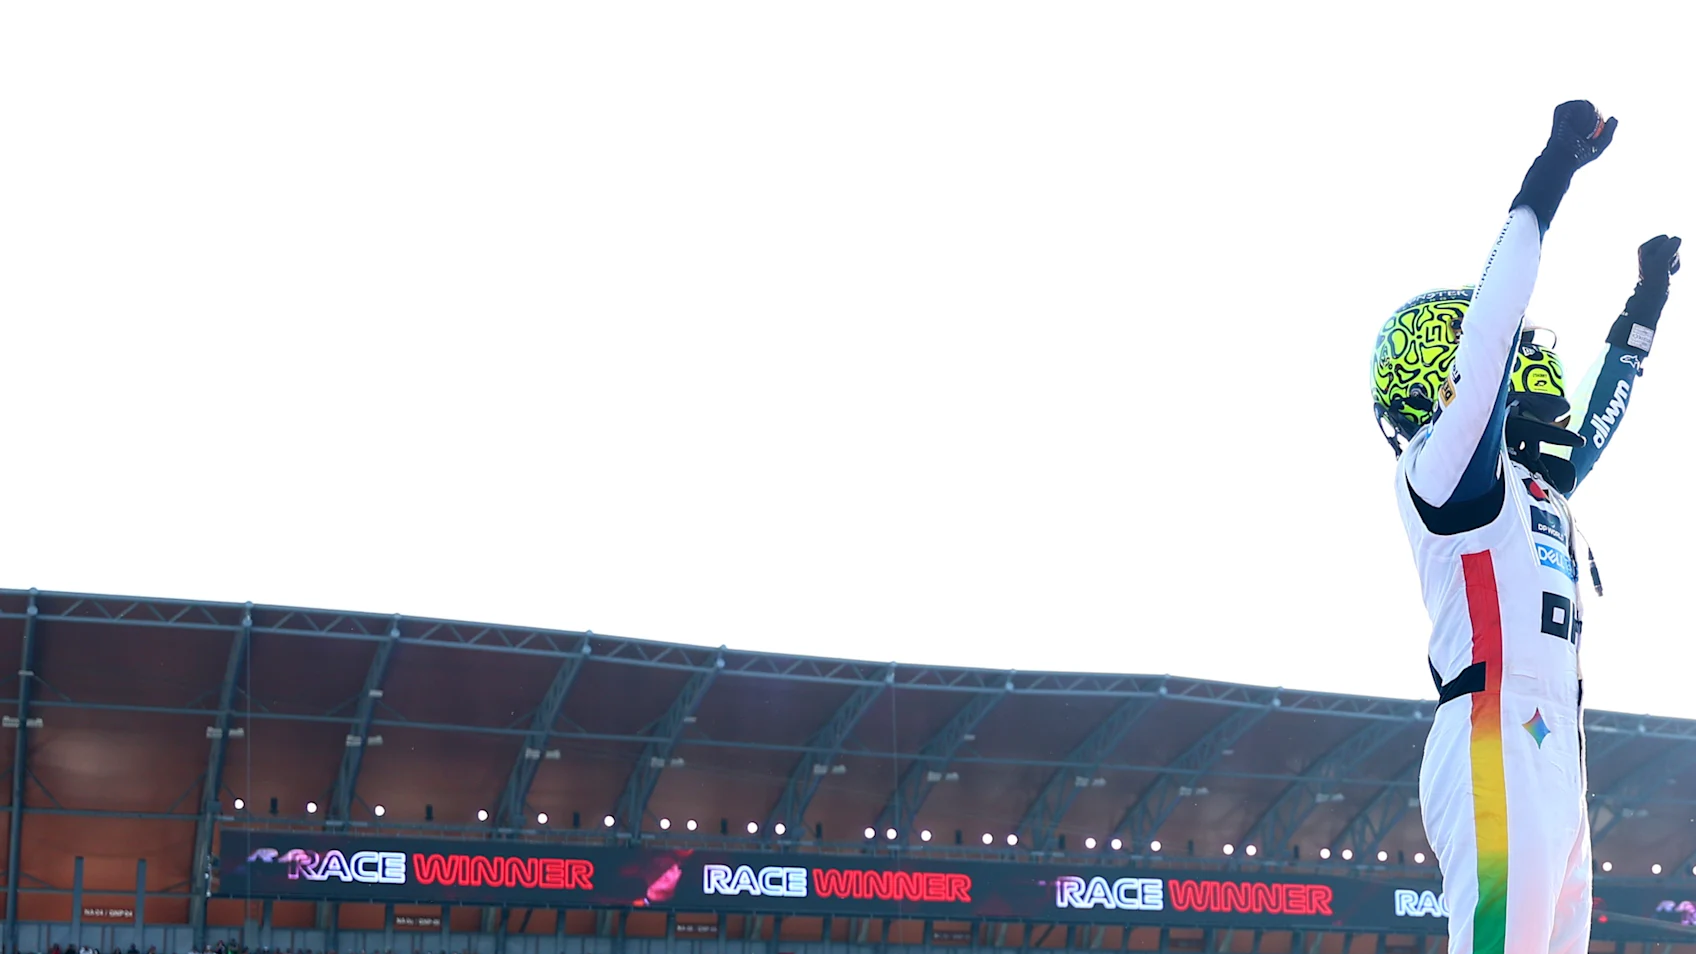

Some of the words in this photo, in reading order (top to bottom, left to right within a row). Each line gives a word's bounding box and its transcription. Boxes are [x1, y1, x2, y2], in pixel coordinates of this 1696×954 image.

[1538, 546, 1564, 571] DELL
[287, 850, 406, 884] RACE
[413, 853, 593, 890] WINNER
[703, 864, 808, 897] RACE
[813, 868, 972, 902] WINNER
[1056, 876, 1164, 911] RACE
[1168, 879, 1333, 916] WINNER
